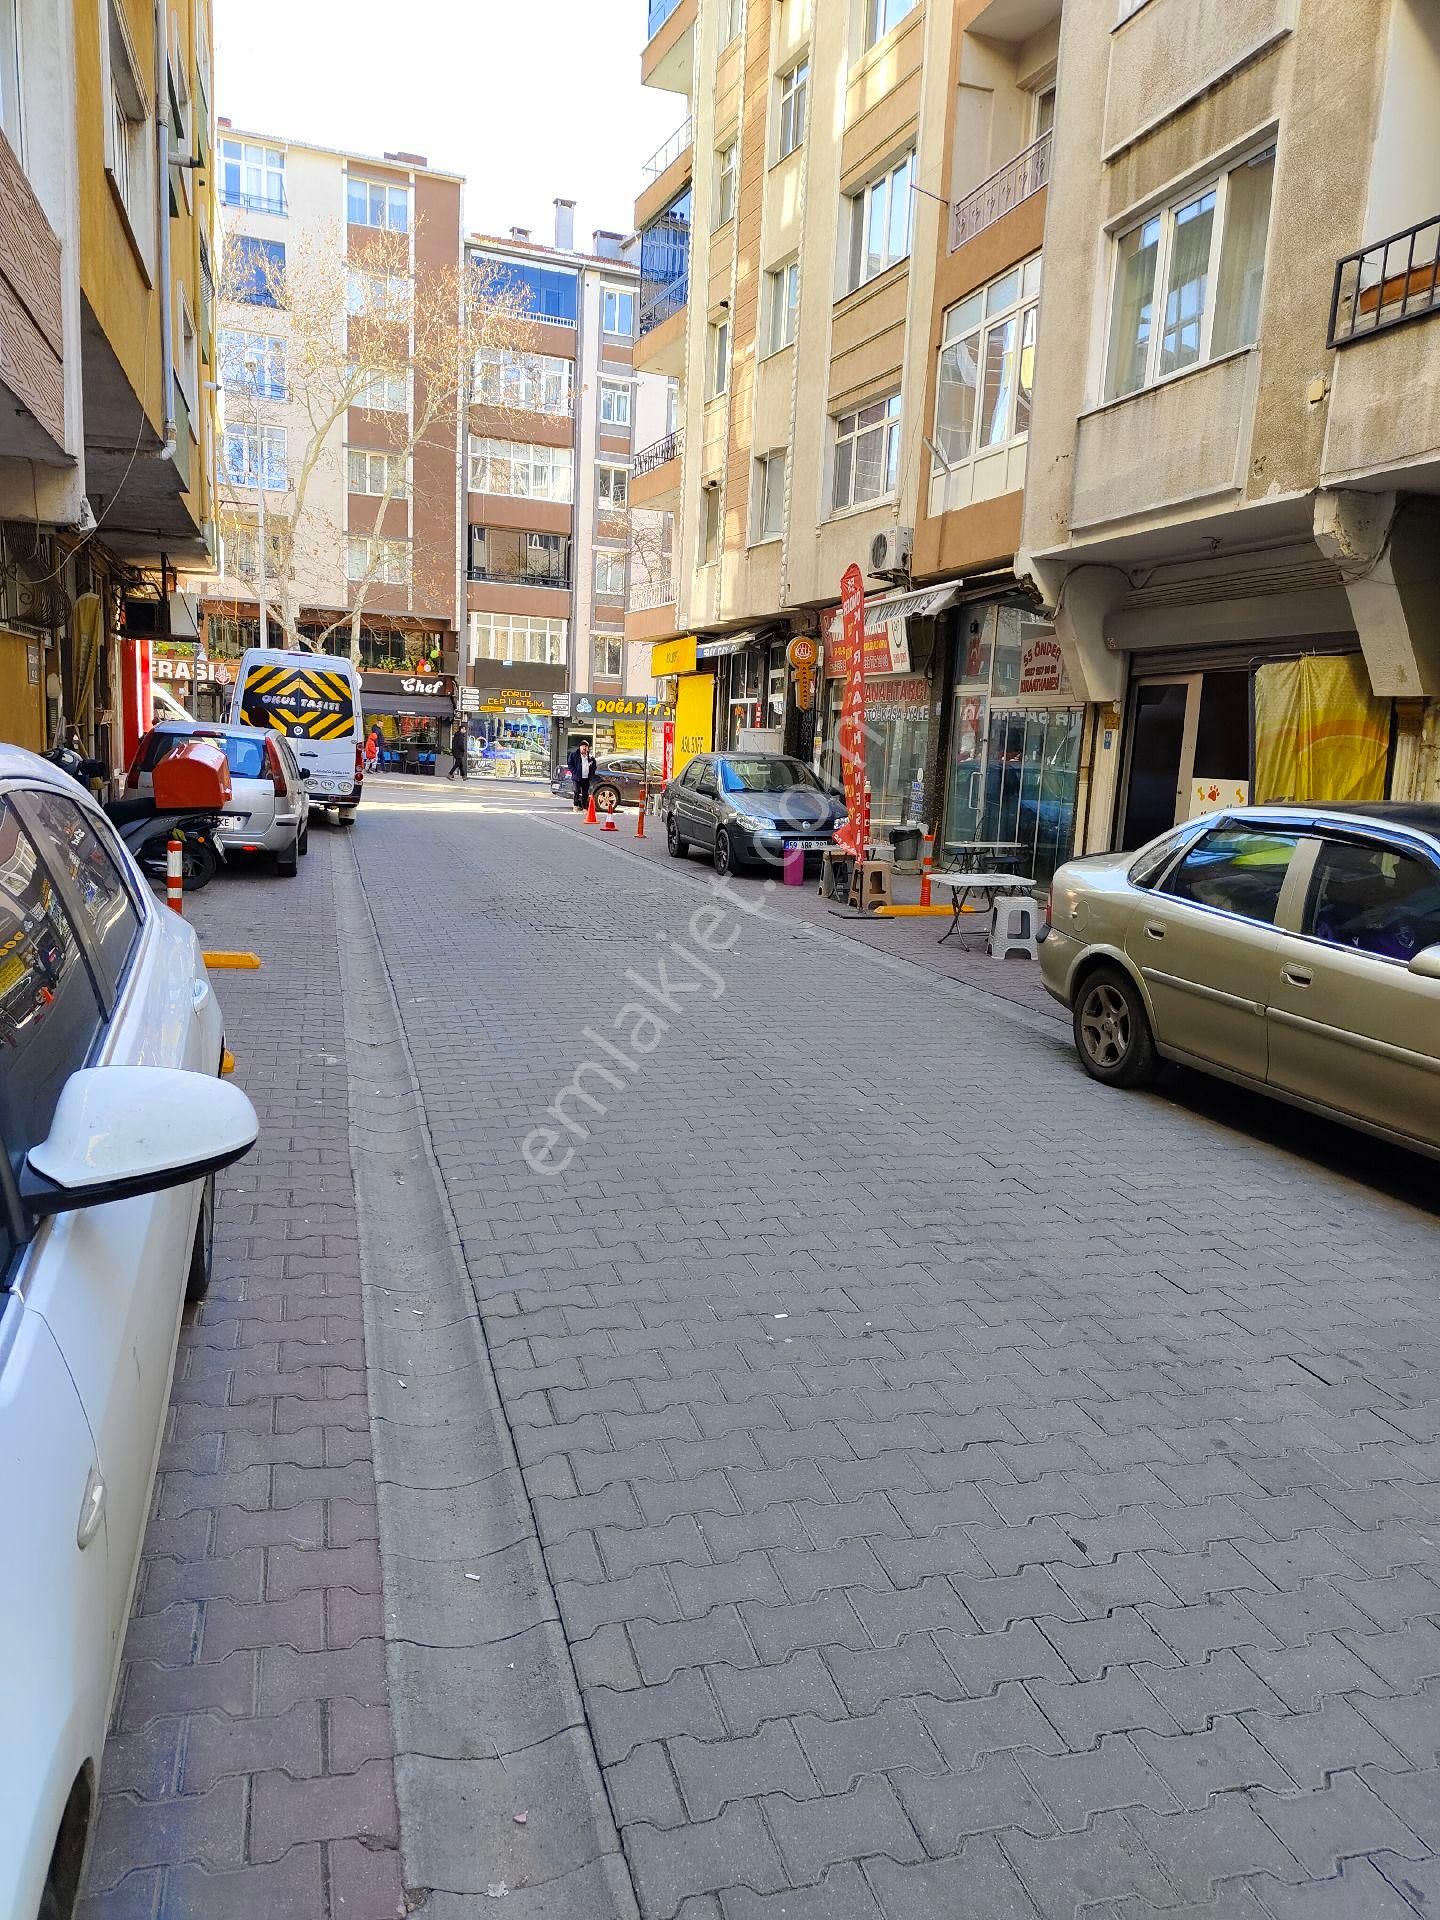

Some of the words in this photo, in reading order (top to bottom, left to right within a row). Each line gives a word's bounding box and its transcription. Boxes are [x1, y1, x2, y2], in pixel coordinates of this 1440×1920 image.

[401, 678, 443, 693] Chef
[262, 694, 296, 706] OKUL
[300, 698, 340, 711] TAŞITI
[487, 697, 506, 705] CEP
[596, 698, 633, 714] DOĞA
